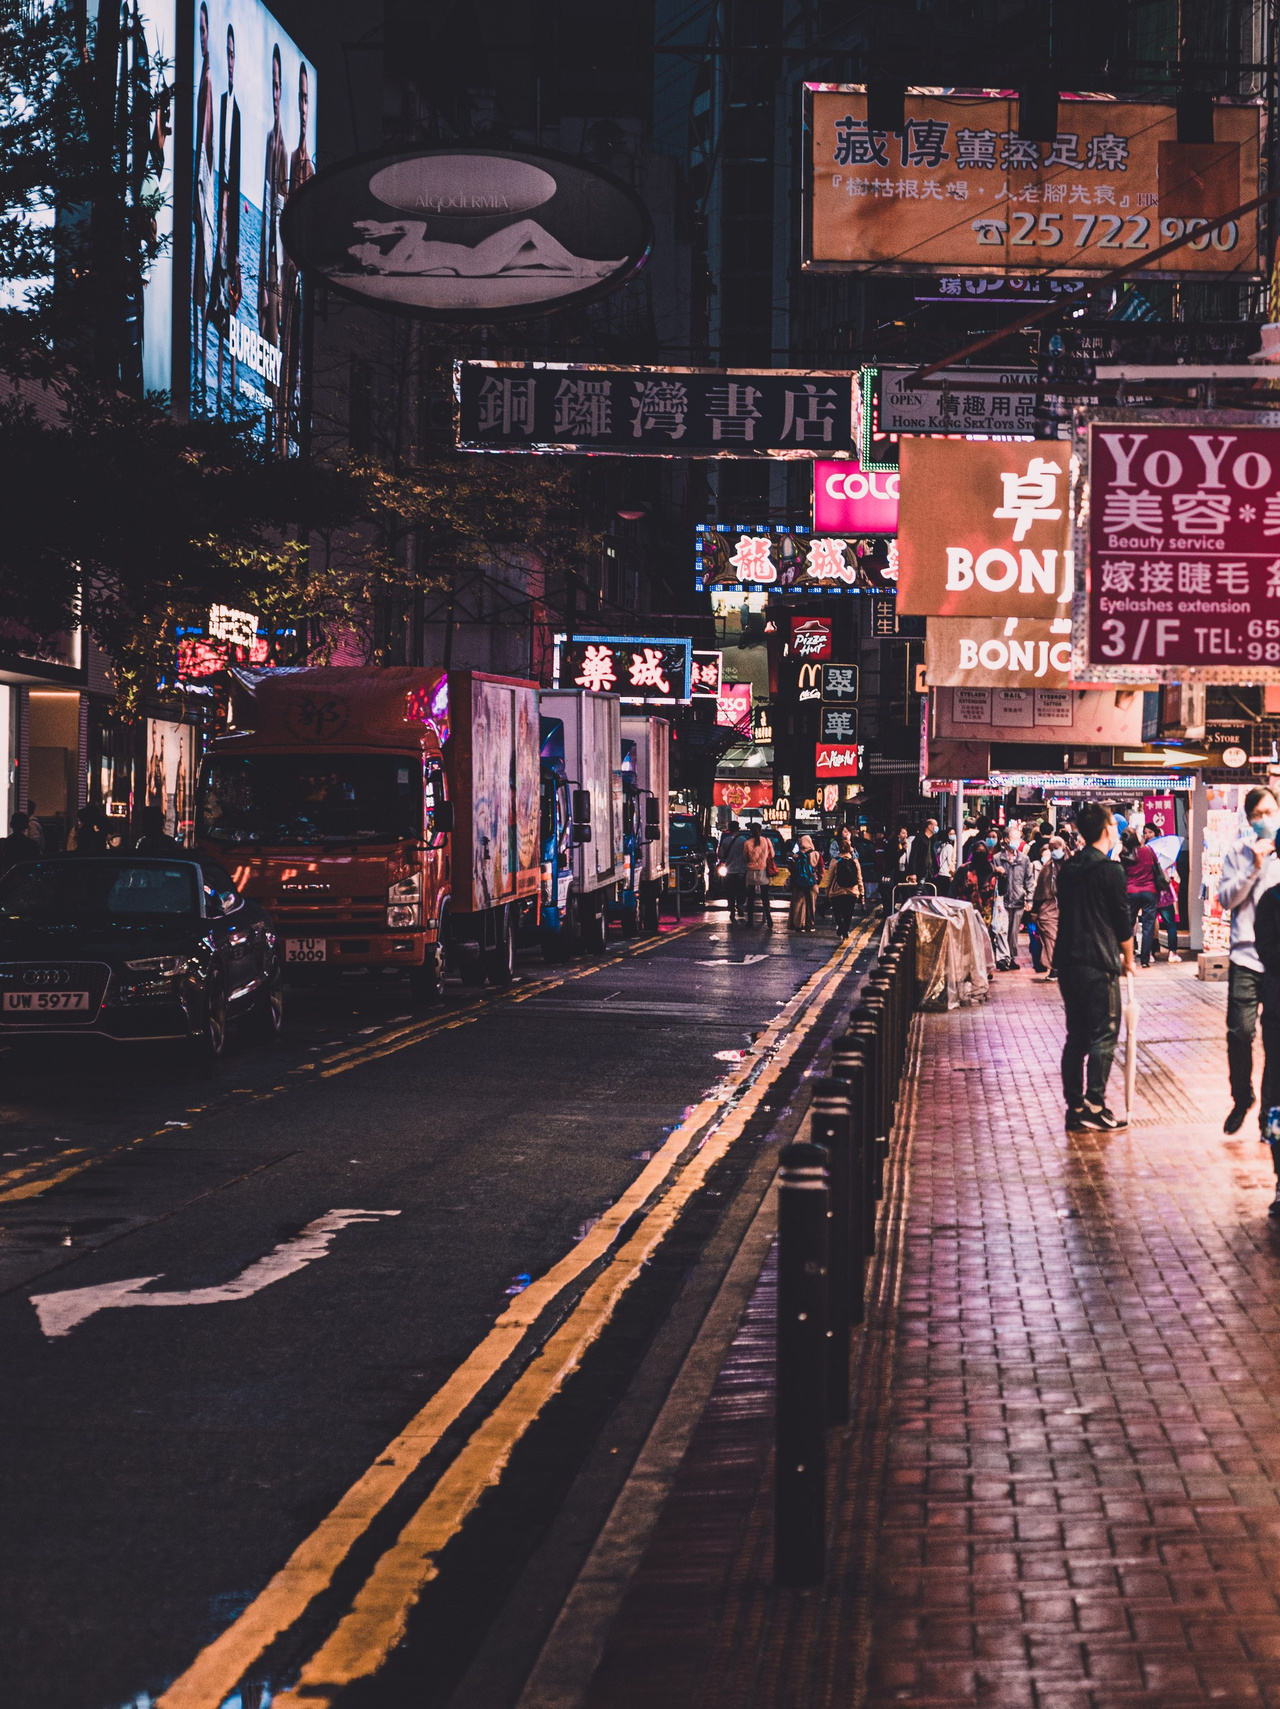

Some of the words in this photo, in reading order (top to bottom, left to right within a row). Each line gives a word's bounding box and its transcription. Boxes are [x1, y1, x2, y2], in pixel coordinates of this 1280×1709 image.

[229, 314, 283, 388] BURBERRY
[476, 375, 839, 443] 銅鑼灣書店
[890, 395, 923, 406] OPEN
[937, 395, 1034, 417] 情趣用品
[993, 457, 1063, 541] 卓
[1102, 489, 1232, 535] 美容
[1108, 534, 1165, 552] Beauty
[1168, 536, 1226, 550] service
[1101, 560, 1250, 595] 嫁接睫毛
[1099, 597, 1173, 615] Eyelashes
[1177, 599, 1251, 614] extension
[794, 632, 828, 649] Pizza
[1101, 619, 1180, 661] 3/F
[1194, 628, 1243, 654] TEL:
[799, 644, 826, 657] Hut
[574, 645, 670, 694] 藥城
[960, 691, 987, 699] EYELASH
[1003, 691, 1023, 699] NAIL
[282, 884, 330, 893] ISUZU
[297, 939, 315, 950] TU
[289, 950, 325, 962] 3009
[9, 994, 30, 1009] UW
[37, 993, 85, 1008] 5977
